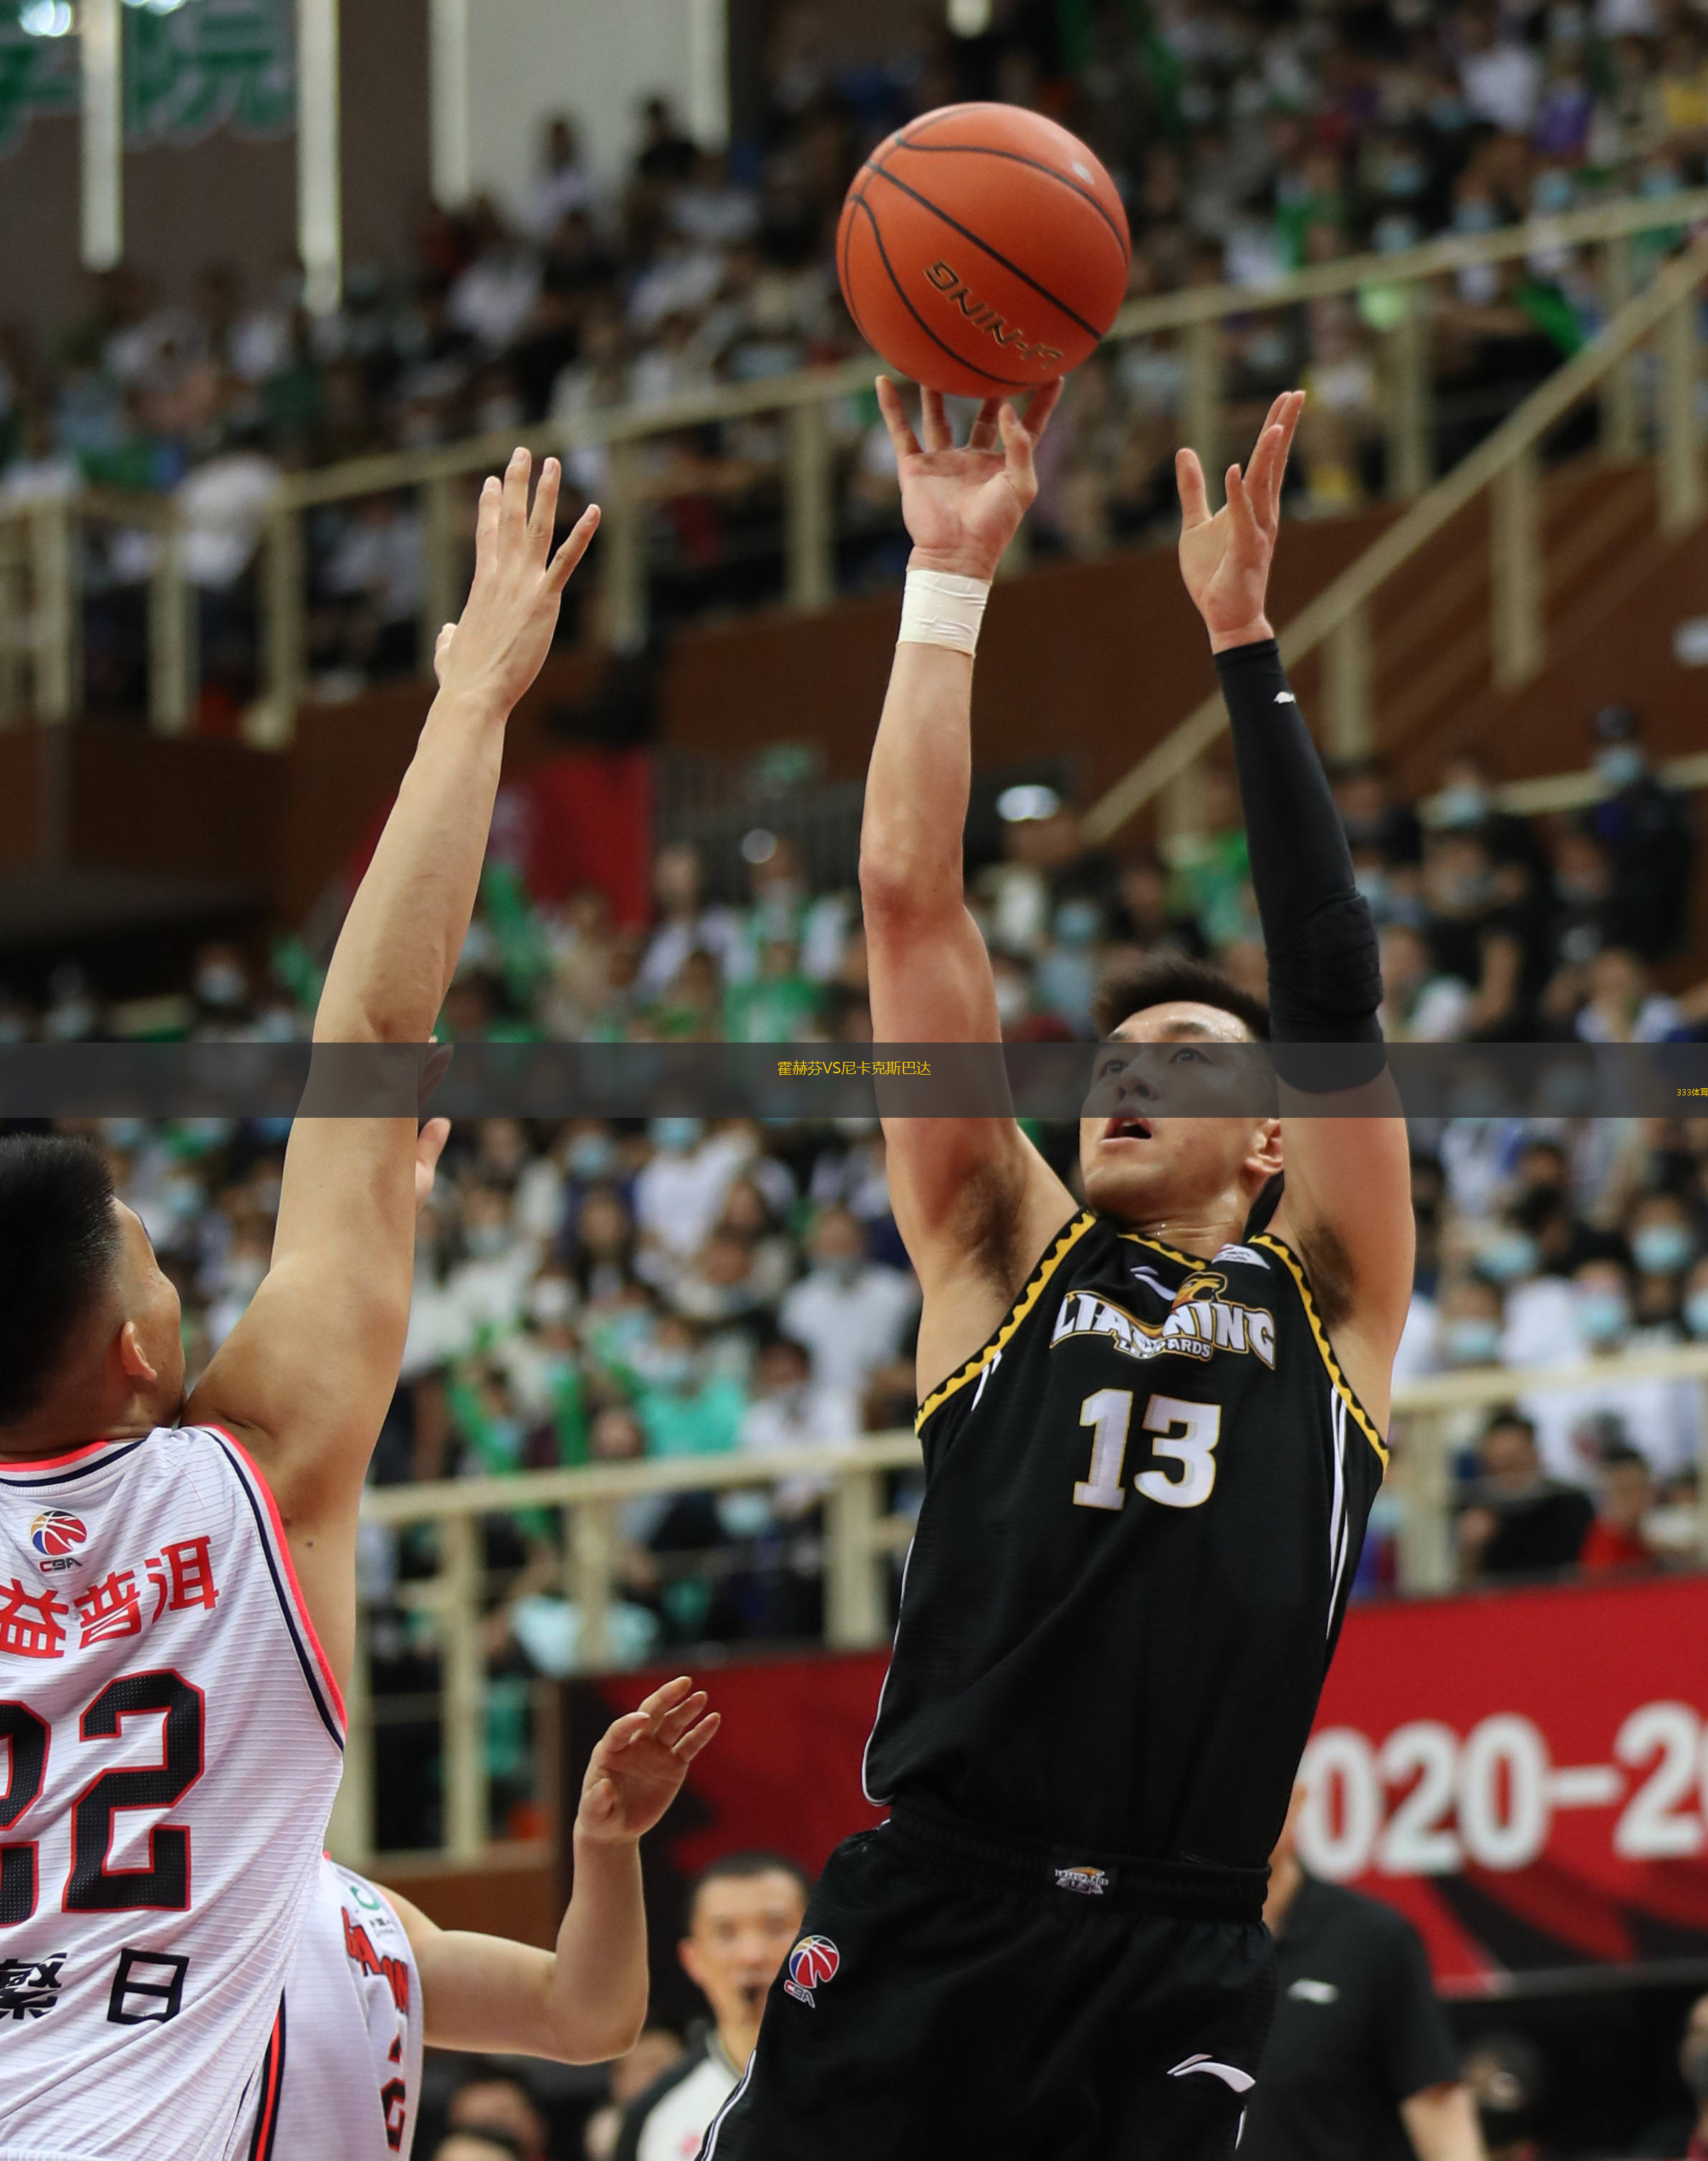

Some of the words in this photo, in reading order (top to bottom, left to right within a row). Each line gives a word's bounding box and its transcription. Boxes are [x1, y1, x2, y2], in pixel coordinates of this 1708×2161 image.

[1118, 1337, 1212, 1359] LPARDS
[1073, 1387, 1221, 1510] 13
[39, 1557, 83, 1573] CBA
[1292, 1698, 1708, 1882] 020-2
[784, 1979, 815, 2008] CBA
